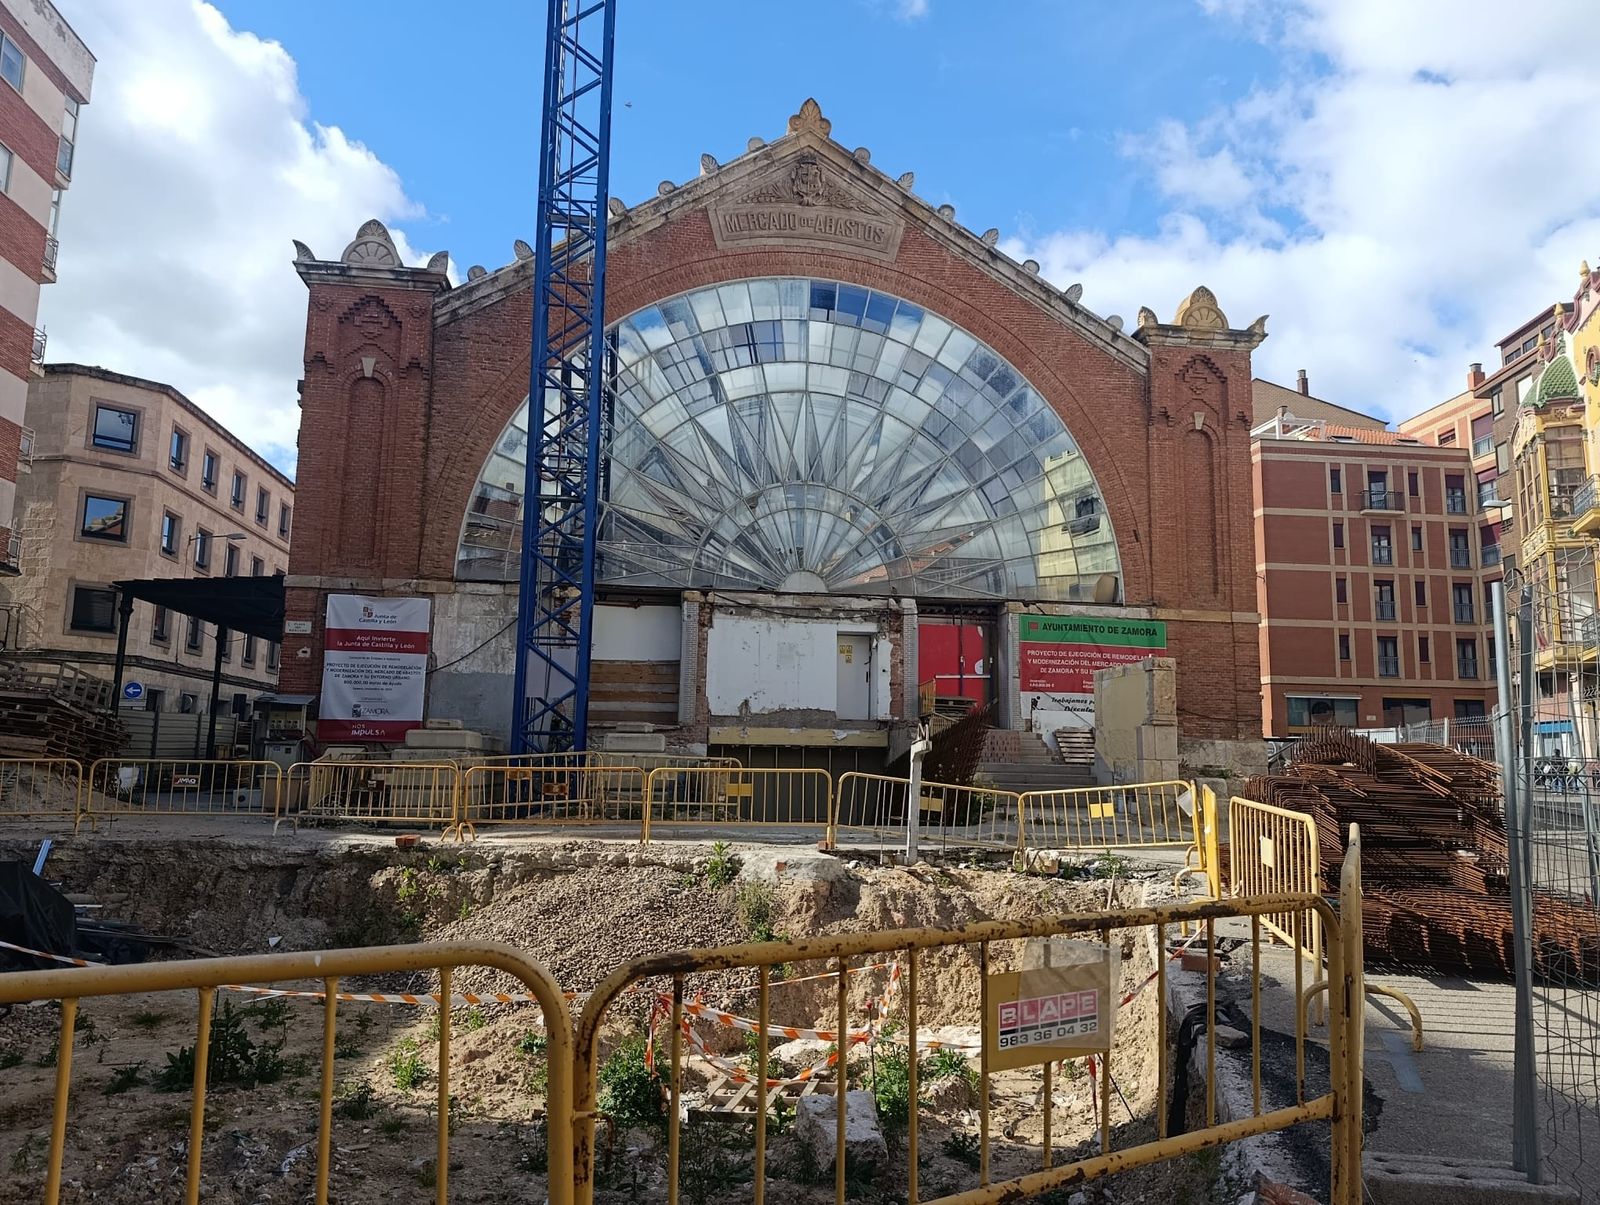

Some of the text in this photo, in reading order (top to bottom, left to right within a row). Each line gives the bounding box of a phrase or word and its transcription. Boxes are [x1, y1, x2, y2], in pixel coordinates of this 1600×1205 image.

[723, 212, 885, 244] MERCADO DE ABASTOS
[1042, 622, 1158, 637] AYUNTAMIENTO DE ZAMORA
[1001, 994, 1095, 1025] BLAPE
[1000, 1021, 1097, 1048] 983 36 04 32
